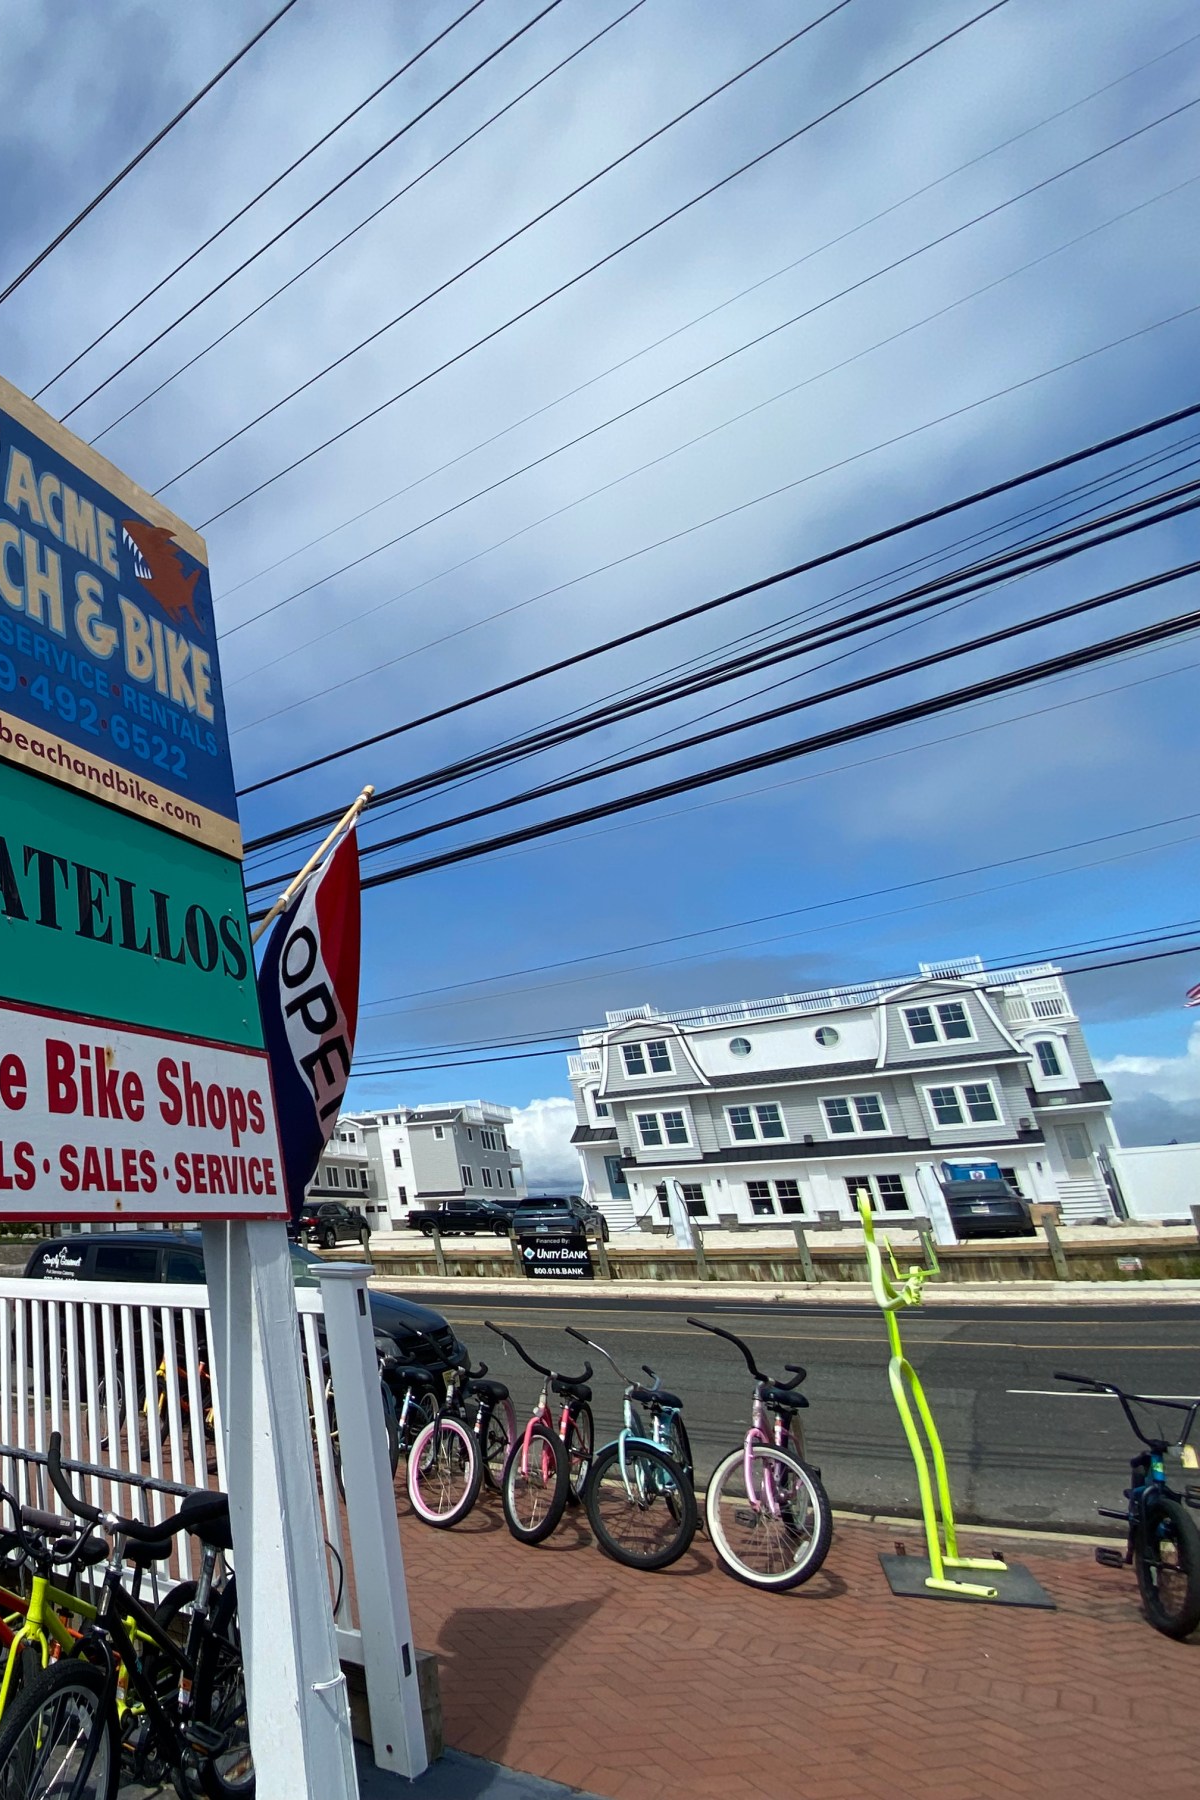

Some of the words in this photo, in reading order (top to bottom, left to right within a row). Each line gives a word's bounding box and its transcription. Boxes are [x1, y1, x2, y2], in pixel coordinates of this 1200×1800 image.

[4, 445, 120, 581] ACME
[75, 571, 118, 660] &
[118, 594, 215, 724] BIKE
[122, 684, 218, 758] RENTALS
[45, 1038, 145, 1122] Bike
[156, 1056, 266, 1148] Shops
[59, 1143, 158, 1193] SALES
[175, 1151, 278, 1196] SERVICE
